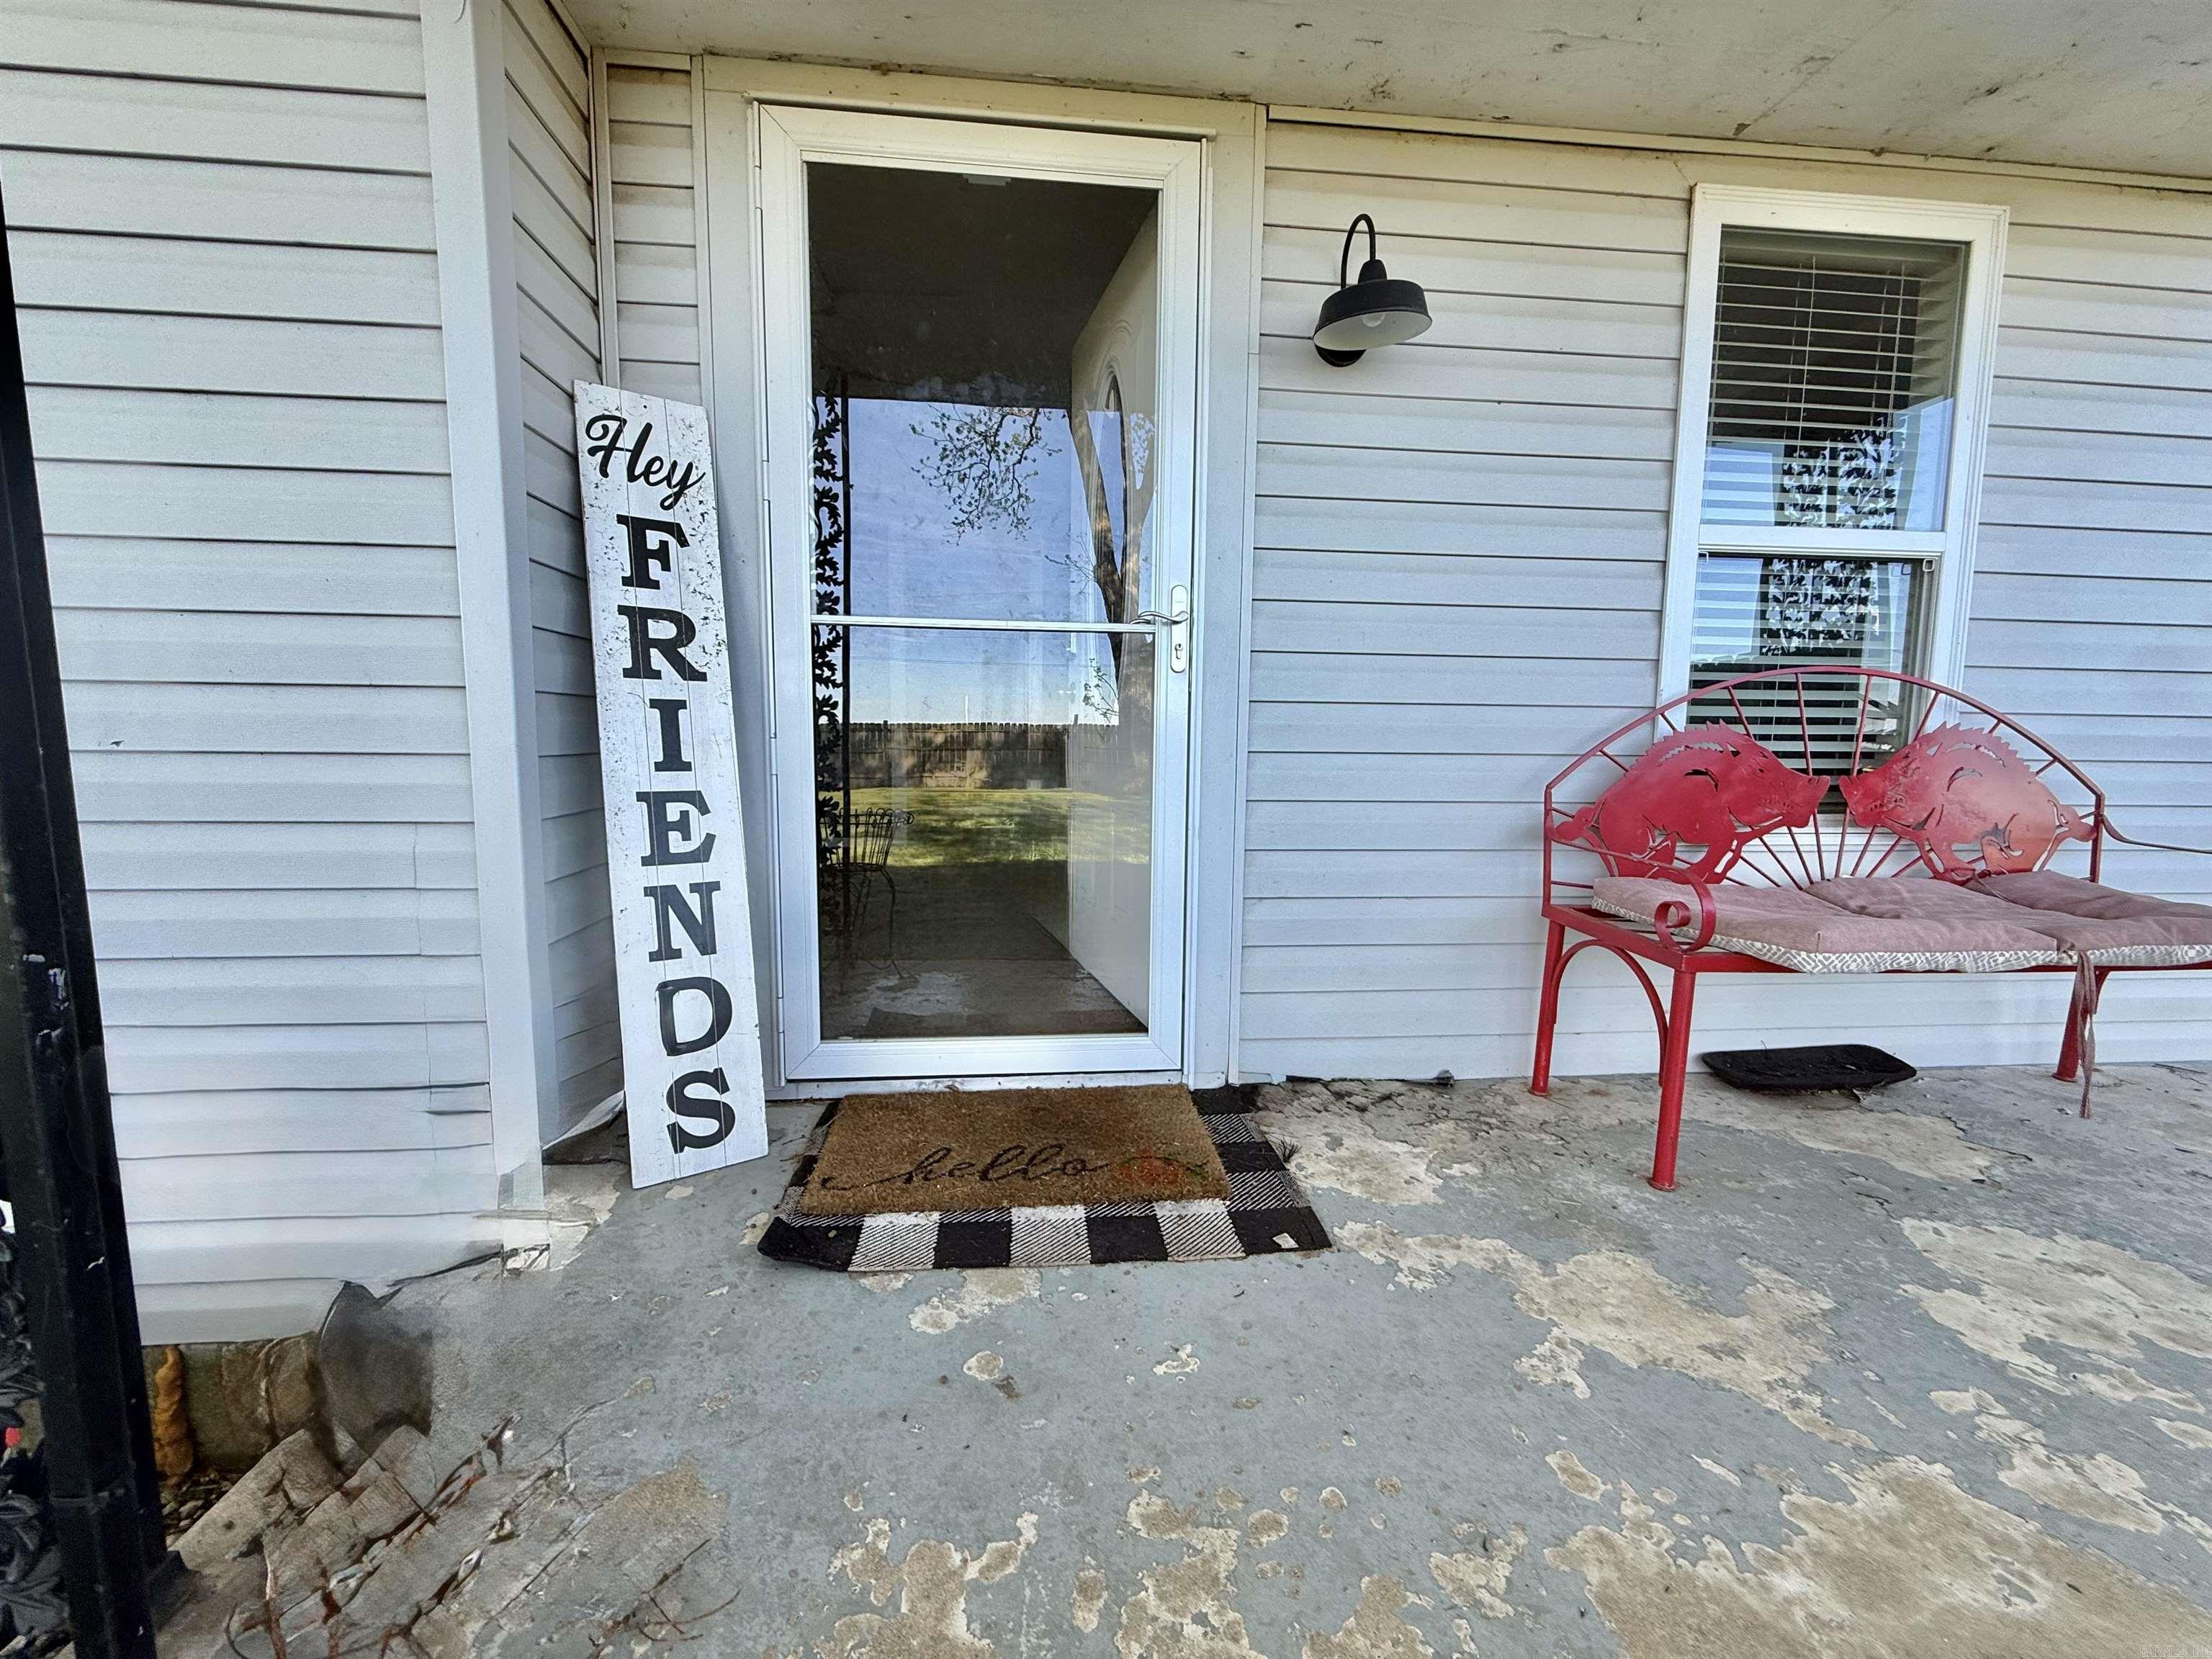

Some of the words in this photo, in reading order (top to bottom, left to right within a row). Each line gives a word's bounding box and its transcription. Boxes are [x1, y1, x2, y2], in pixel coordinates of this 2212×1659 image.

[585, 414, 706, 511] Hey
[616, 513, 736, 1155] FRIENDS
[820, 1142, 1111, 1192] hello
